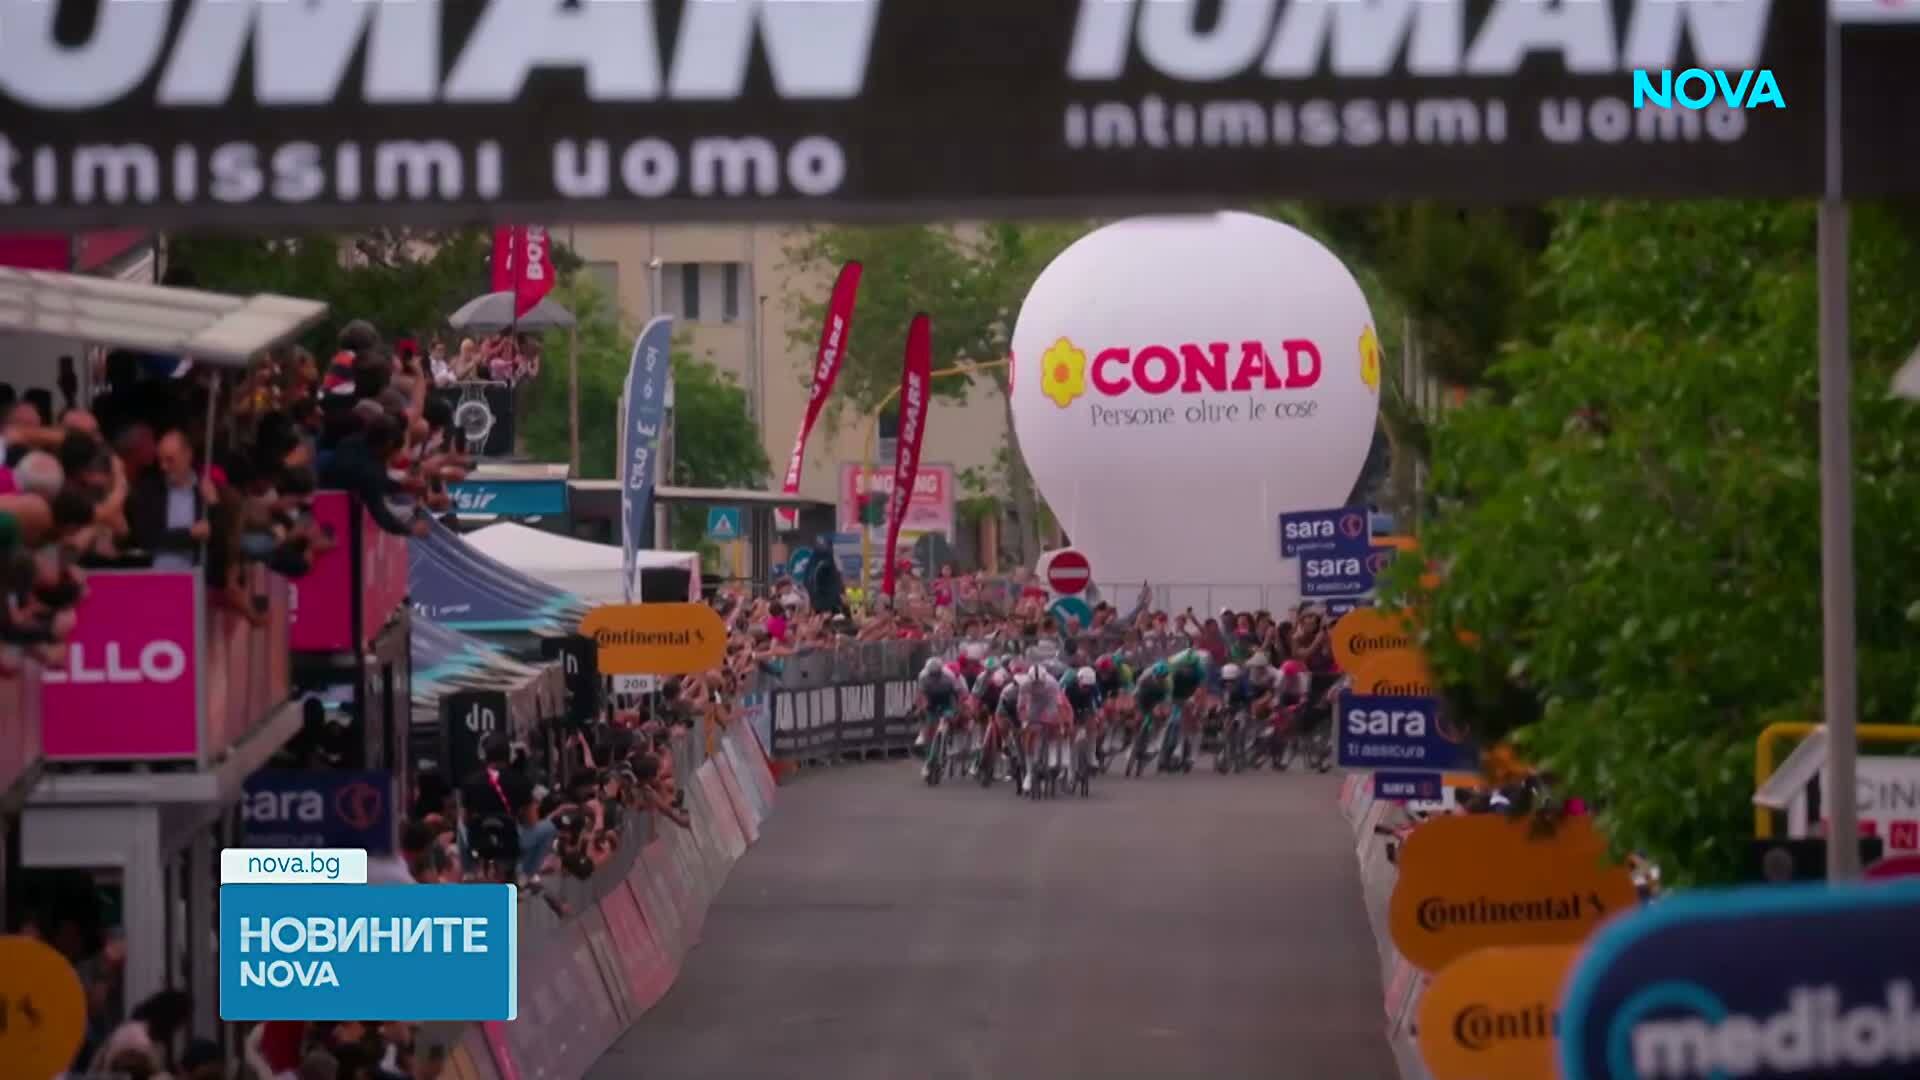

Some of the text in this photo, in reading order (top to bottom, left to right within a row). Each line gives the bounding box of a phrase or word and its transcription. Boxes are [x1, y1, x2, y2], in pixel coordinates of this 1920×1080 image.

[1065, 95, 1748, 147] intimissimi uomo
[553, 134, 847, 198] uomo
[1091, 337, 1322, 396] CONAD
[902, 371, 921, 443] DARE
[1091, 397, 1320, 427] Persone oltre le cose
[1285, 519, 1336, 539] sara
[1306, 557, 1361, 578] sara
[465, 703, 495, 731] dn
[1348, 708, 1426, 737] sara
[1416, 891, 1582, 933] Continental
